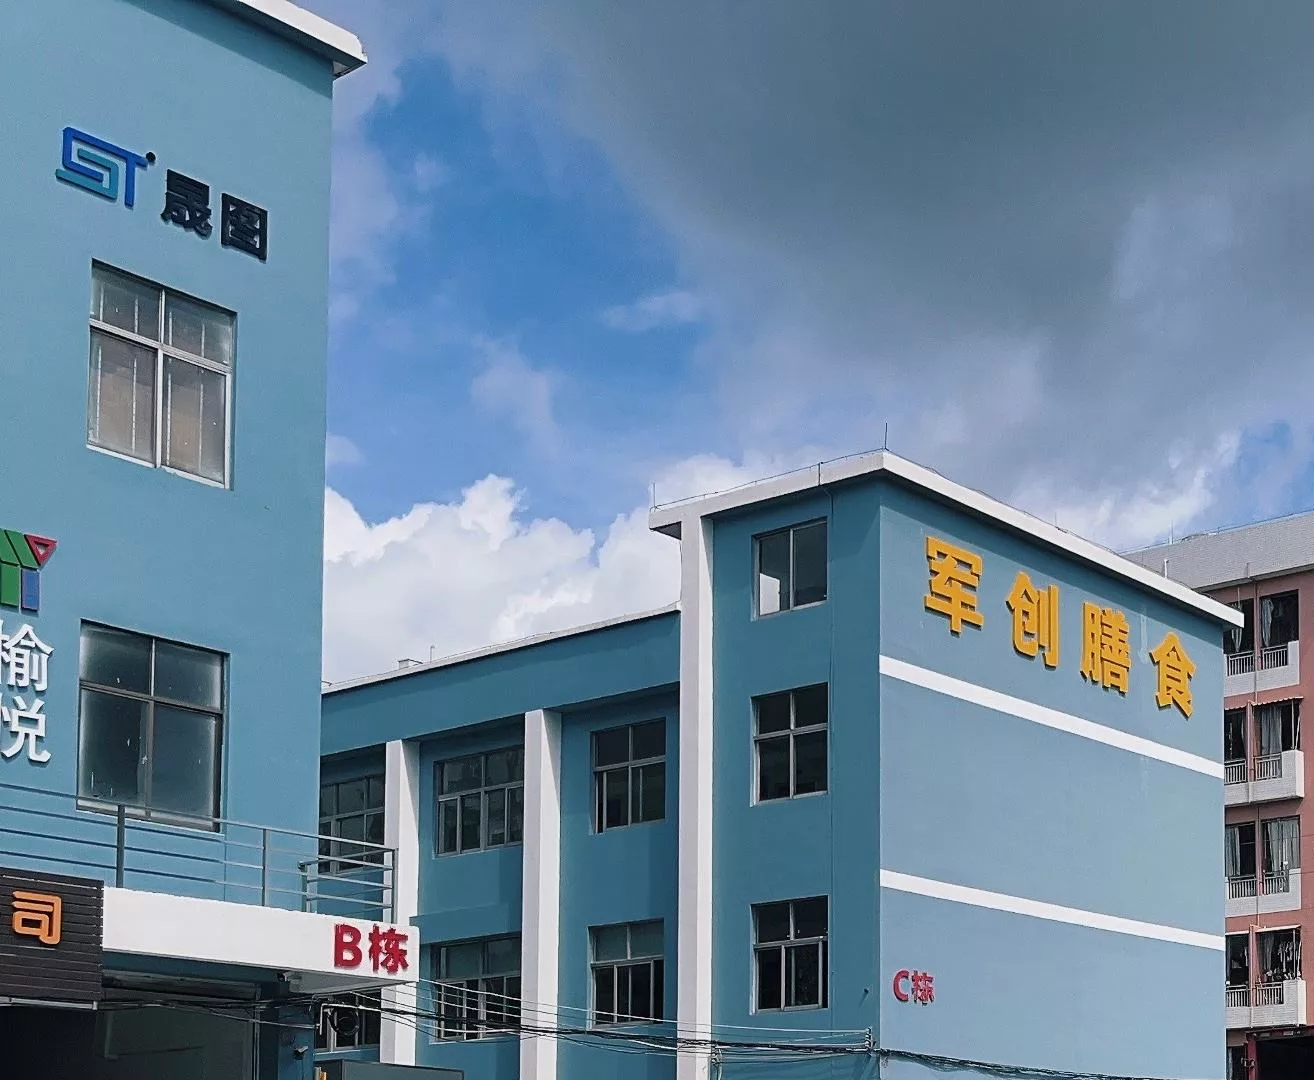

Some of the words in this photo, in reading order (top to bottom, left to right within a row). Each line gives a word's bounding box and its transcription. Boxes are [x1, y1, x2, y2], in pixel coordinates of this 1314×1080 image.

[160, 169, 267, 263] 晟图
[924, 536, 1197, 718] 军创膳食
[12, 890, 62, 945] 司
[334, 924, 409, 974] B栋
[893, 970, 934, 1006] C栋
